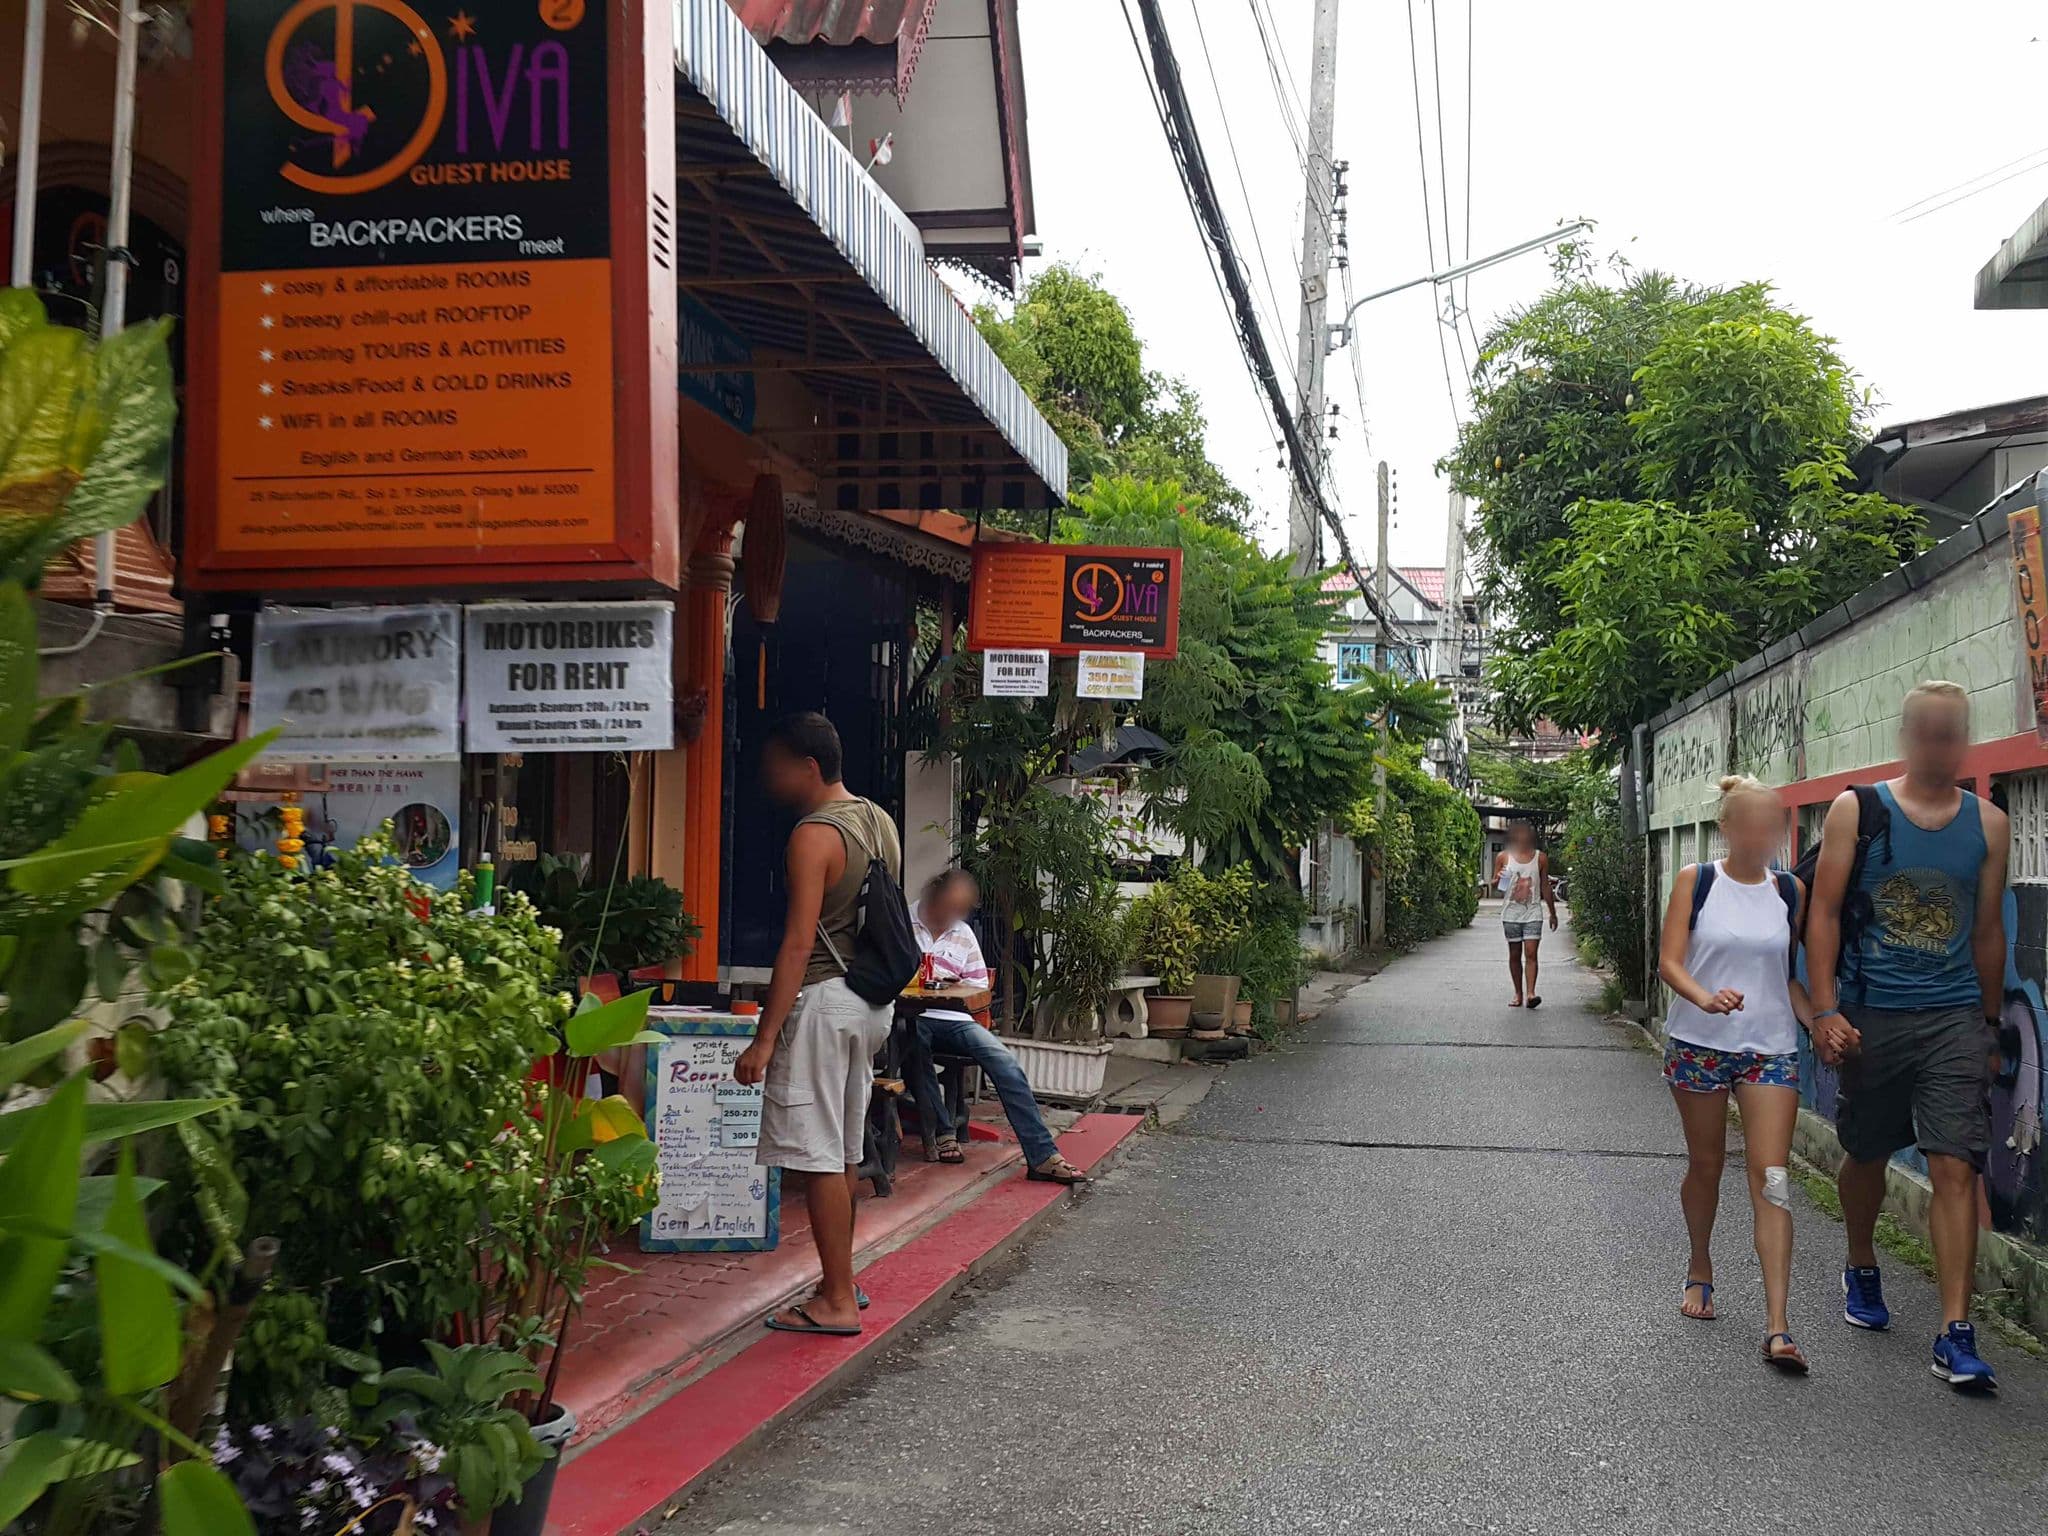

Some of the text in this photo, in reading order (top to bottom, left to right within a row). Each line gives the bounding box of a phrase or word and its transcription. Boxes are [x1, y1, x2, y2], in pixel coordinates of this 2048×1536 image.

[411, 159, 571, 186] GUEST HOUSE
[260, 206, 315, 225] where
[309, 214, 524, 247] BACKPACKERS
[519, 236, 565, 255] meet
[283, 270, 531, 297] cosy & affordable ROOMS
[283, 304, 531, 330] breezy chill-out ROOFTOP
[283, 337, 566, 364] exciting TOURS & ACTIVITIES
[282, 371, 572, 396] Snacks/Food & COLD DRINKS
[329, 412, 346, 428] in
[353, 410, 374, 427] all
[382, 408, 457, 426] ROOMS
[301, 446, 528, 467] English and German spoken
[1135, 615, 1157, 623] HOUSE
[484, 620, 655, 650] MOTORBIKES
[1082, 629, 1143, 639] BACKPACKERS
[989, 653, 1044, 664] MOTORBIKES
[508, 661, 629, 691] FOR RENT
[996, 667, 1036, 677] FOR RENT
[1088, 672, 1107, 682] 350
[351, 769, 375, 777] THAN
[696, 1040, 729, 1051] private
[718, 1089, 752, 1097] 200-220
[724, 1109, 758, 1117] 250-270
